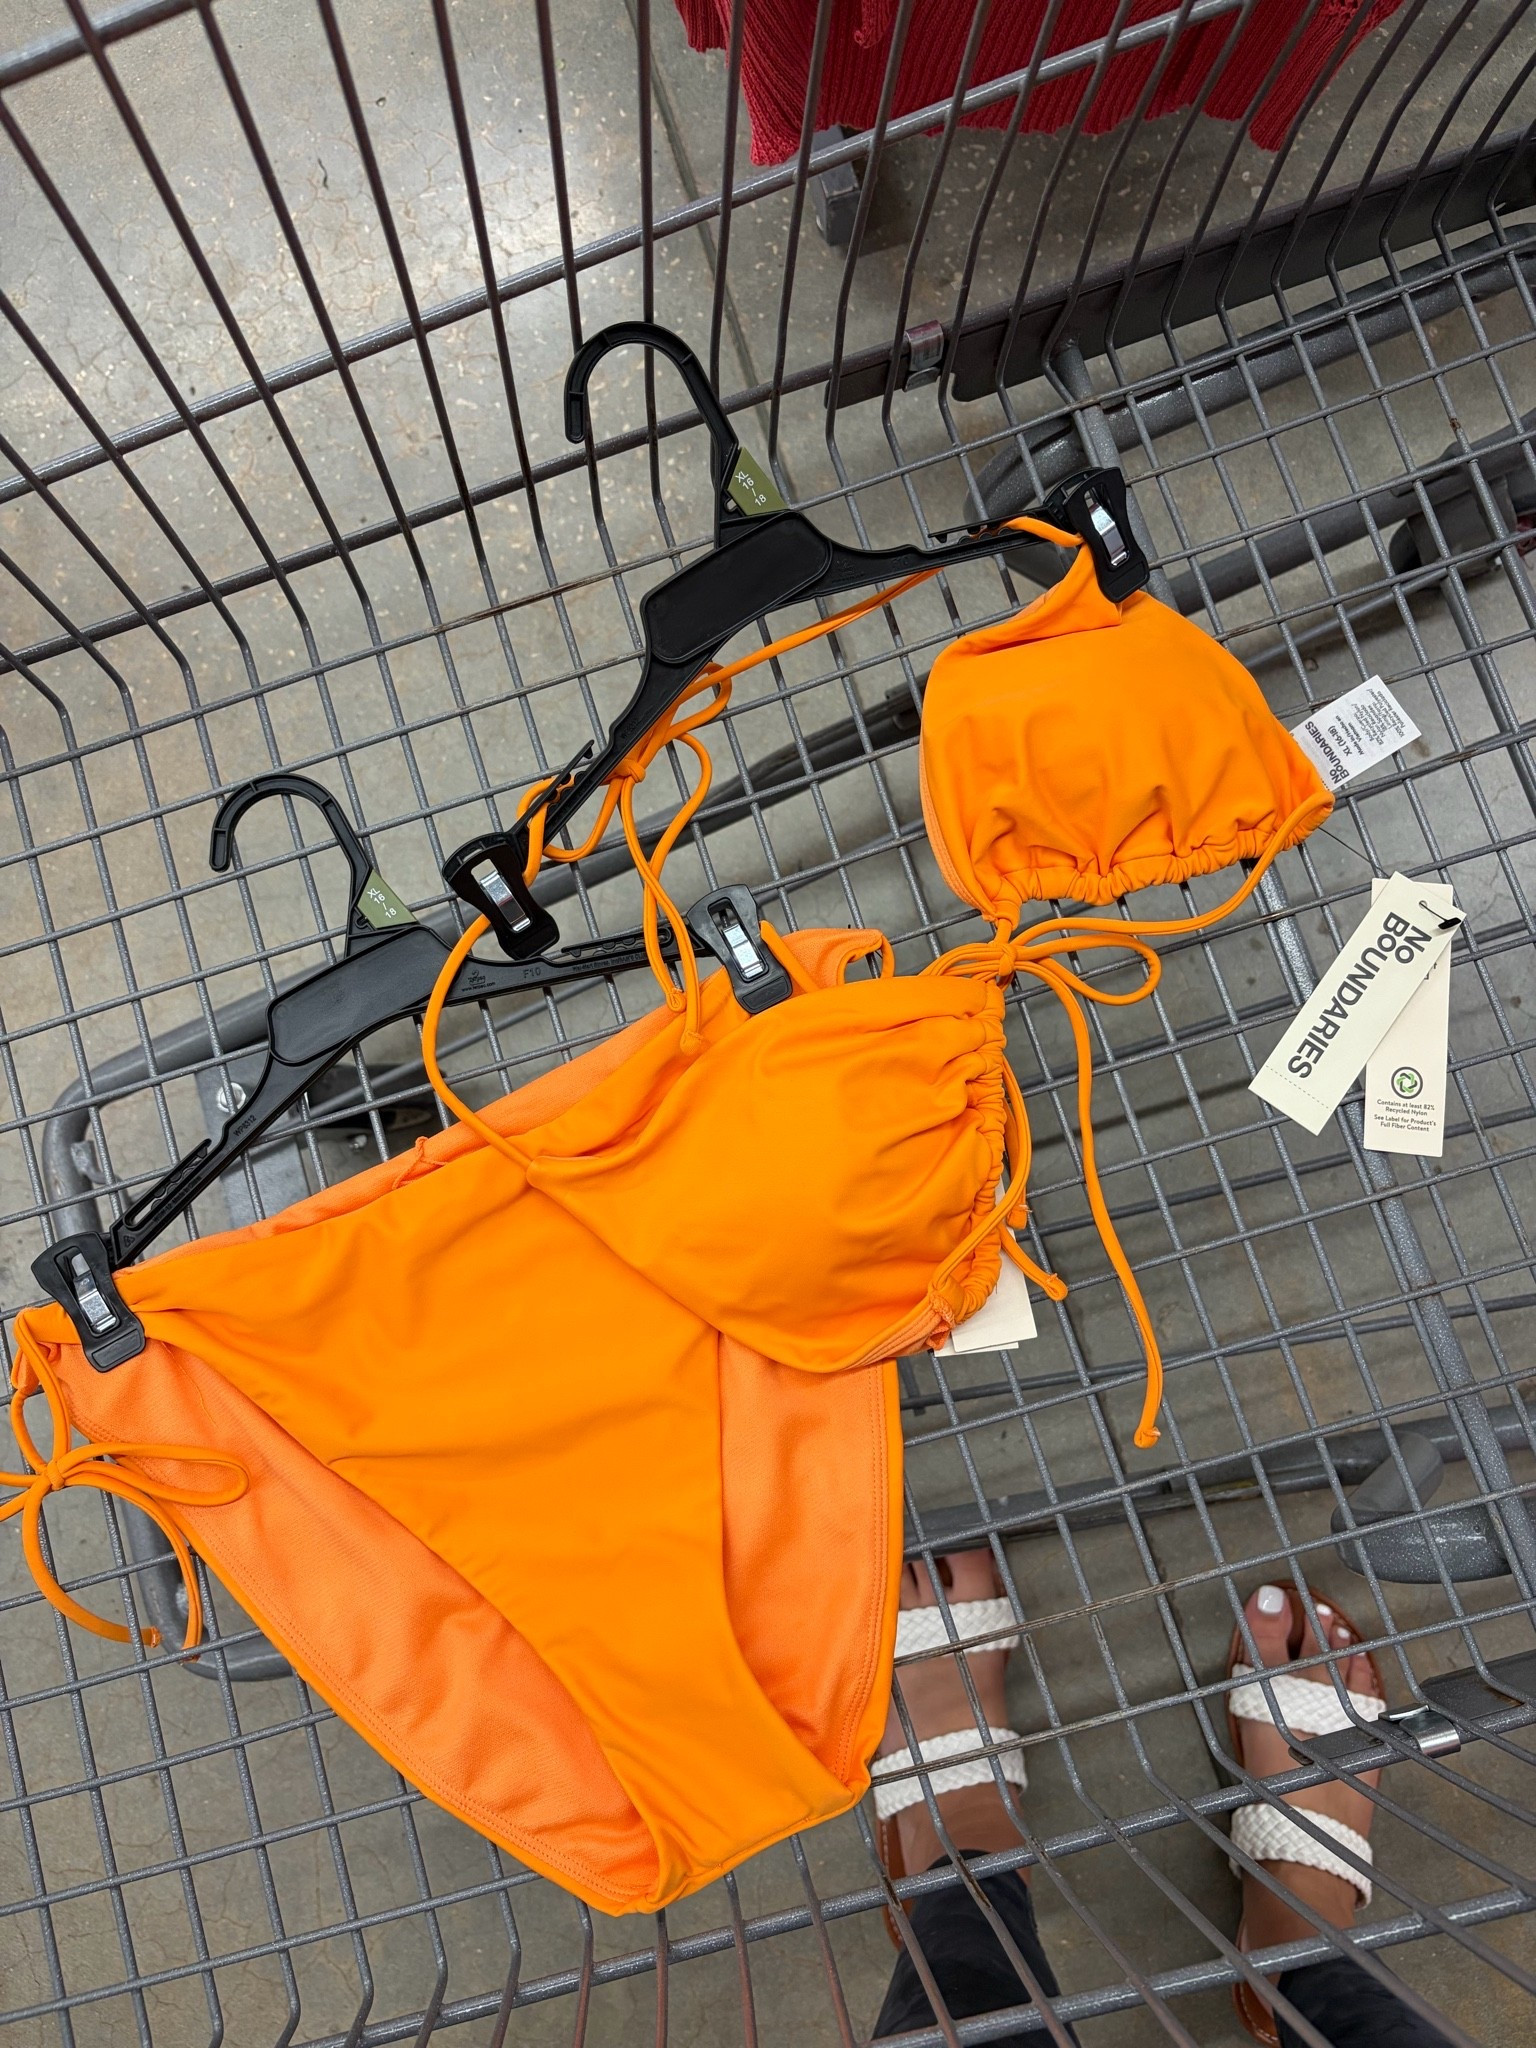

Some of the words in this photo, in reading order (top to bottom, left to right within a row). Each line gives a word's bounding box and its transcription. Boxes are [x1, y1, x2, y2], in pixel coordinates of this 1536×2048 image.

[735, 471, 749, 483] XL
[742, 478, 754, 490] 16
[755, 494, 766, 506] 18
[1327, 725, 1346, 747] (16-18)
[1347, 722, 1362, 742] Vietnam
[1304, 721, 1350, 779] BOUNDARIES
[1342, 746, 1352, 756] XL
[1353, 741, 1364, 756] Made
[1328, 768, 1342, 784] NO
[367, 888, 380, 898] XL
[374, 894, 385, 904] 16
[386, 908, 396, 918] 18
[1395, 925, 1433, 964] NO
[1287, 911, 1410, 1079] BOUNDARIES
[1411, 1118, 1436, 1126] Product's
